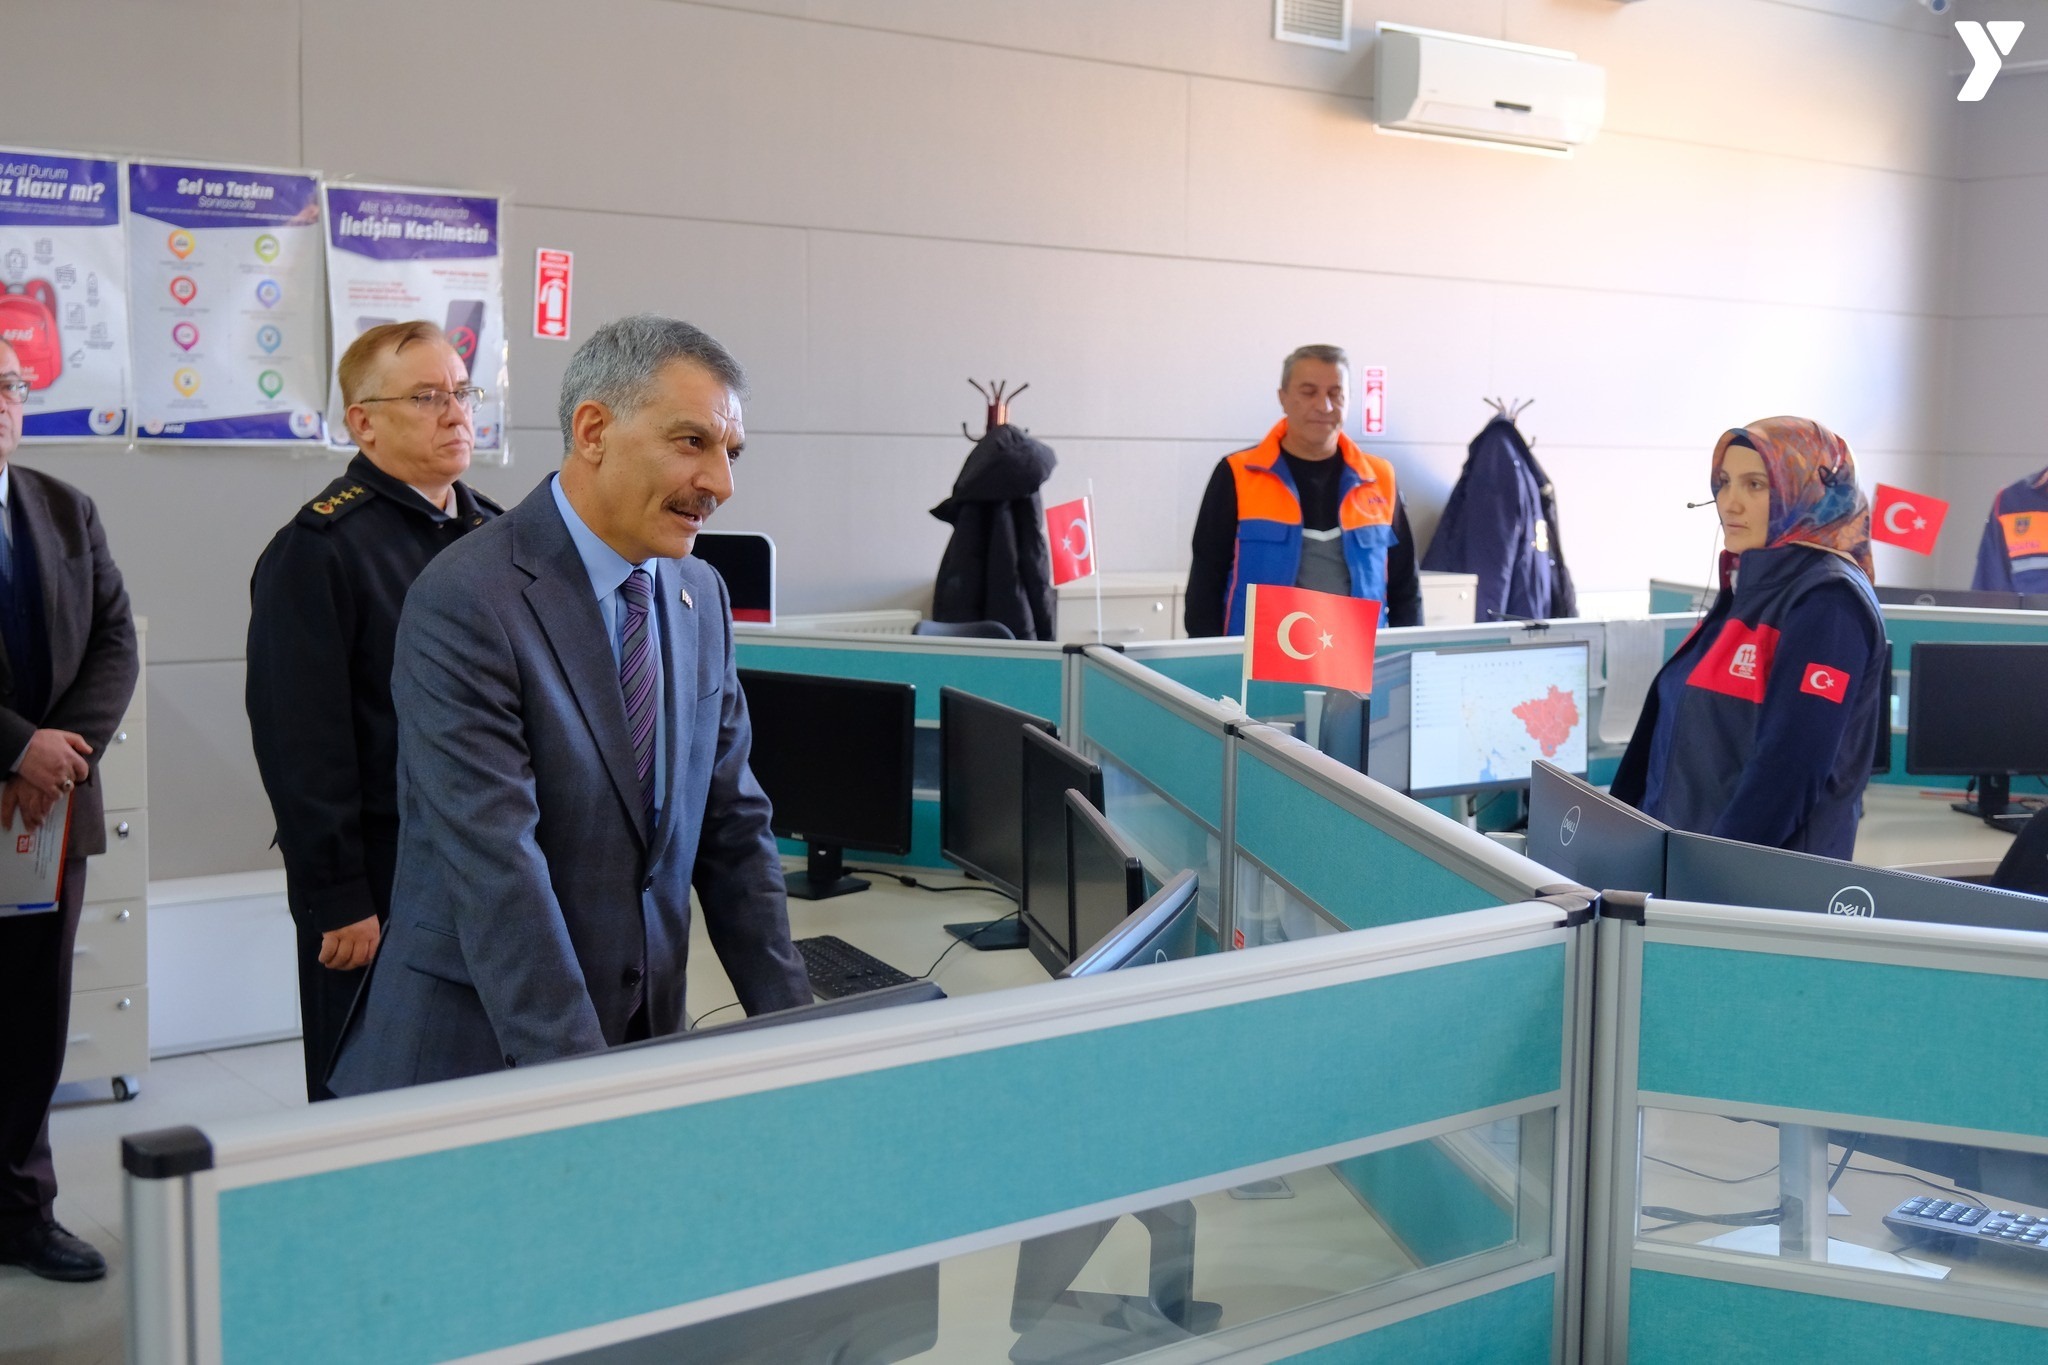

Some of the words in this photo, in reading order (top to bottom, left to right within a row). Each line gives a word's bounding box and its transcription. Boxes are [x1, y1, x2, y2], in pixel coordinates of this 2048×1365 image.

[29, 164, 68, 180] Durum
[16, 177, 67, 200] Hazır
[69, 182, 105, 203] mı?
[177, 178, 204, 195] Sel
[205, 182, 224, 196] ve
[226, 181, 275, 200] Taşkın
[339, 212, 402, 241] İletişim
[404, 220, 489, 244] Kesilmesin
[1834, 902, 1866, 917] DELL
